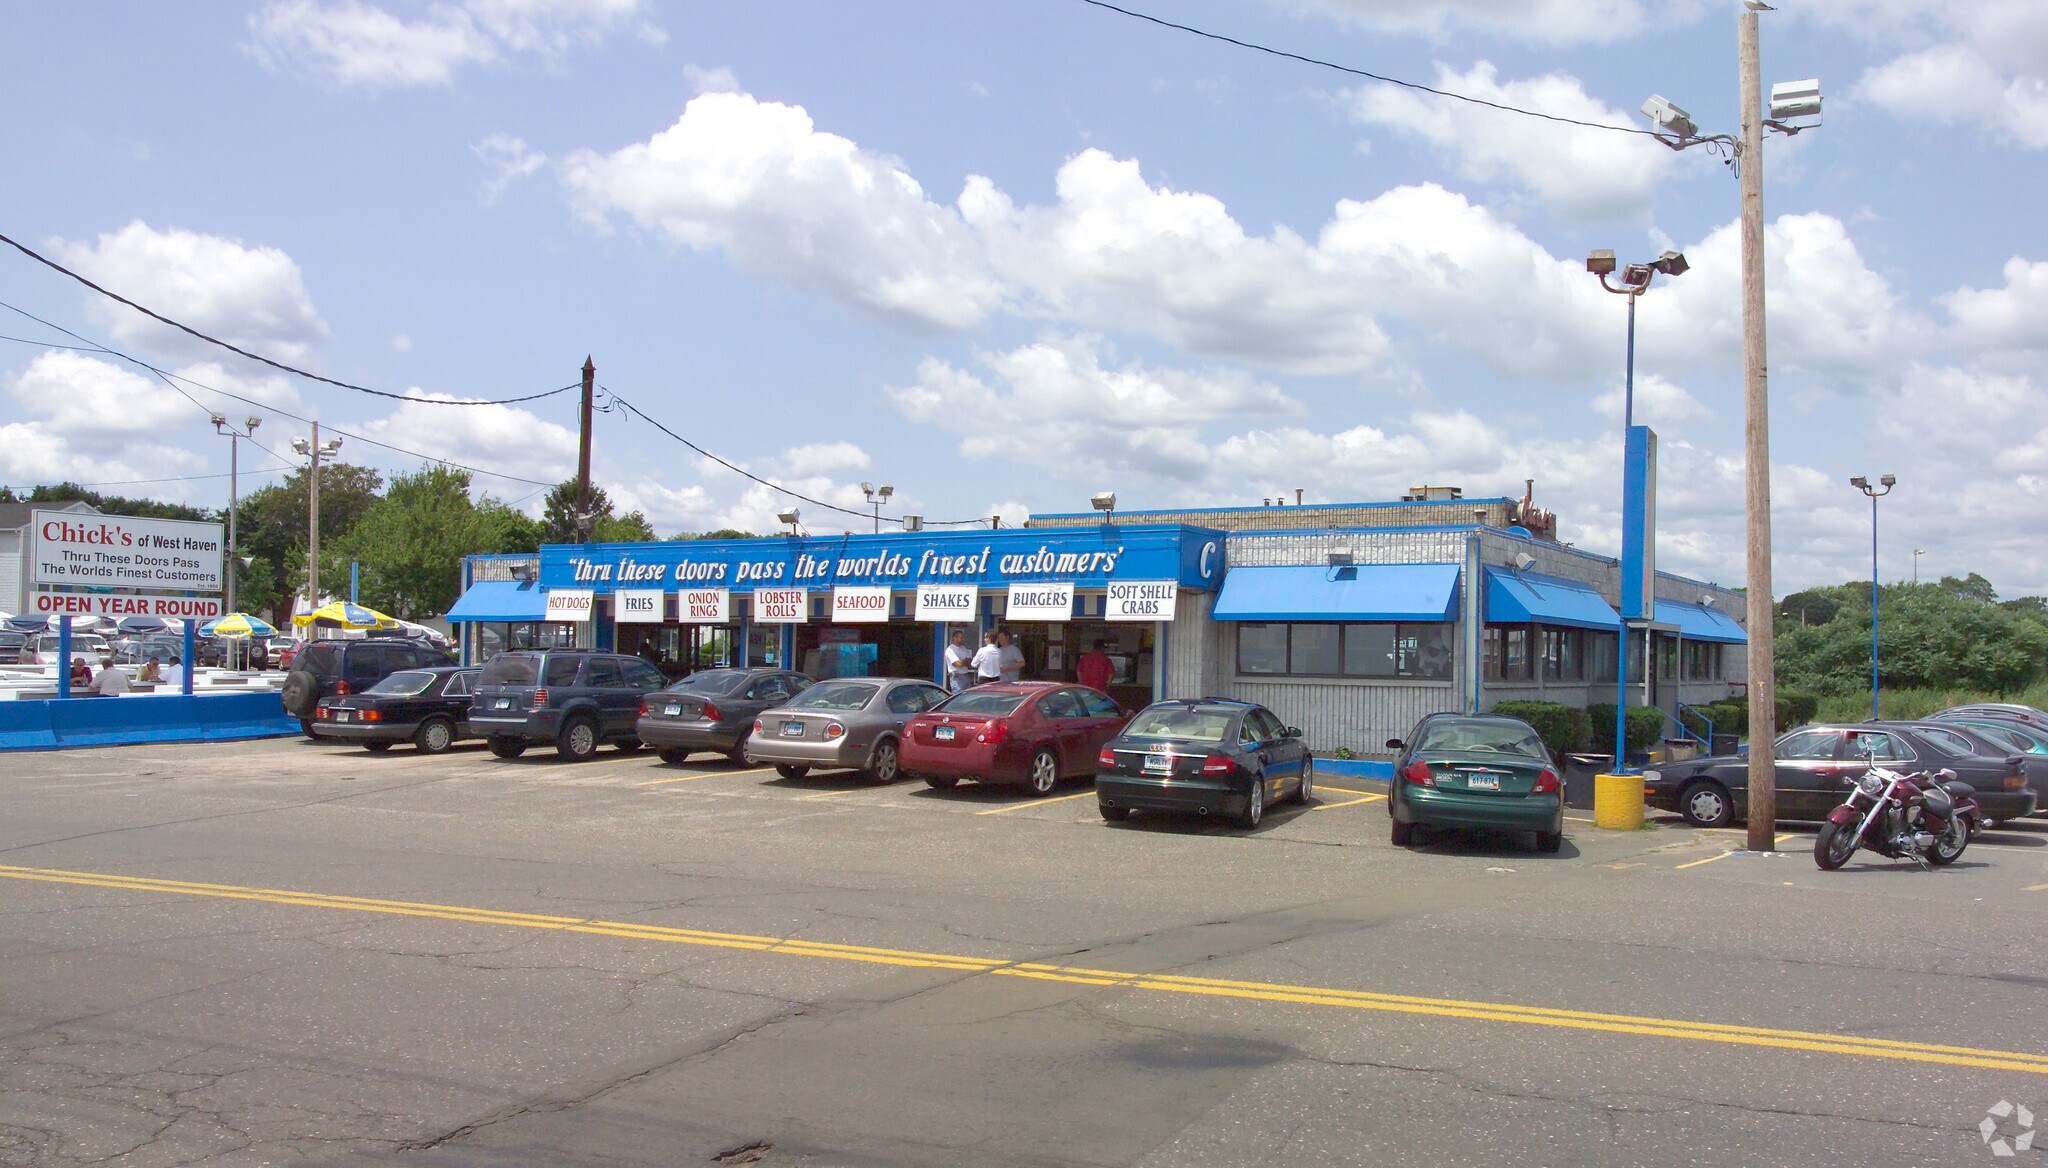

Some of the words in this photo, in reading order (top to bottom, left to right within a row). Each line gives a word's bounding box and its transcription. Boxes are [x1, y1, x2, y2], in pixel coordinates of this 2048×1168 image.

[42, 521, 132, 547] Chick's
[138, 536, 150, 548] of
[153, 535, 181, 550] West
[184, 537, 217, 552] Haven
[62, 550, 91, 563] Thru
[95, 552, 130, 564] These
[135, 554, 170, 567] Doors
[173, 557, 200, 568] Pass
[617, 557, 666, 581] these
[675, 557, 727, 581] doors
[736, 561, 785, 583] pass
[795, 554, 830, 579] the
[836, 550, 911, 576] worlds
[917, 546, 991, 578] finest
[42, 563, 66, 575] The
[69, 564, 112, 577] Worlds
[116, 567, 152, 579] Finest
[155, 568, 216, 582] Customers
[688, 592, 720, 605] ONION
[759, 592, 802, 604] LOBSTER
[1013, 592, 1068, 607] BURGERS
[1110, 585, 1139, 600] SOFT
[1139, 584, 1173, 599] SHELL
[37, 595, 92, 613] OPEN
[98, 598, 152, 615] YEAR
[155, 600, 218, 617] ROUND
[549, 597, 567, 608] HOT
[567, 597, 590, 609] DOGS
[625, 597, 654, 610] FRIES
[835, 595, 886, 610] SEAFOOD
[922, 593, 970, 608] SHAKES
[1121, 600, 1159, 615] CRABS
[690, 605, 718, 617] RINGS
[766, 604, 797, 617] ROLLS
